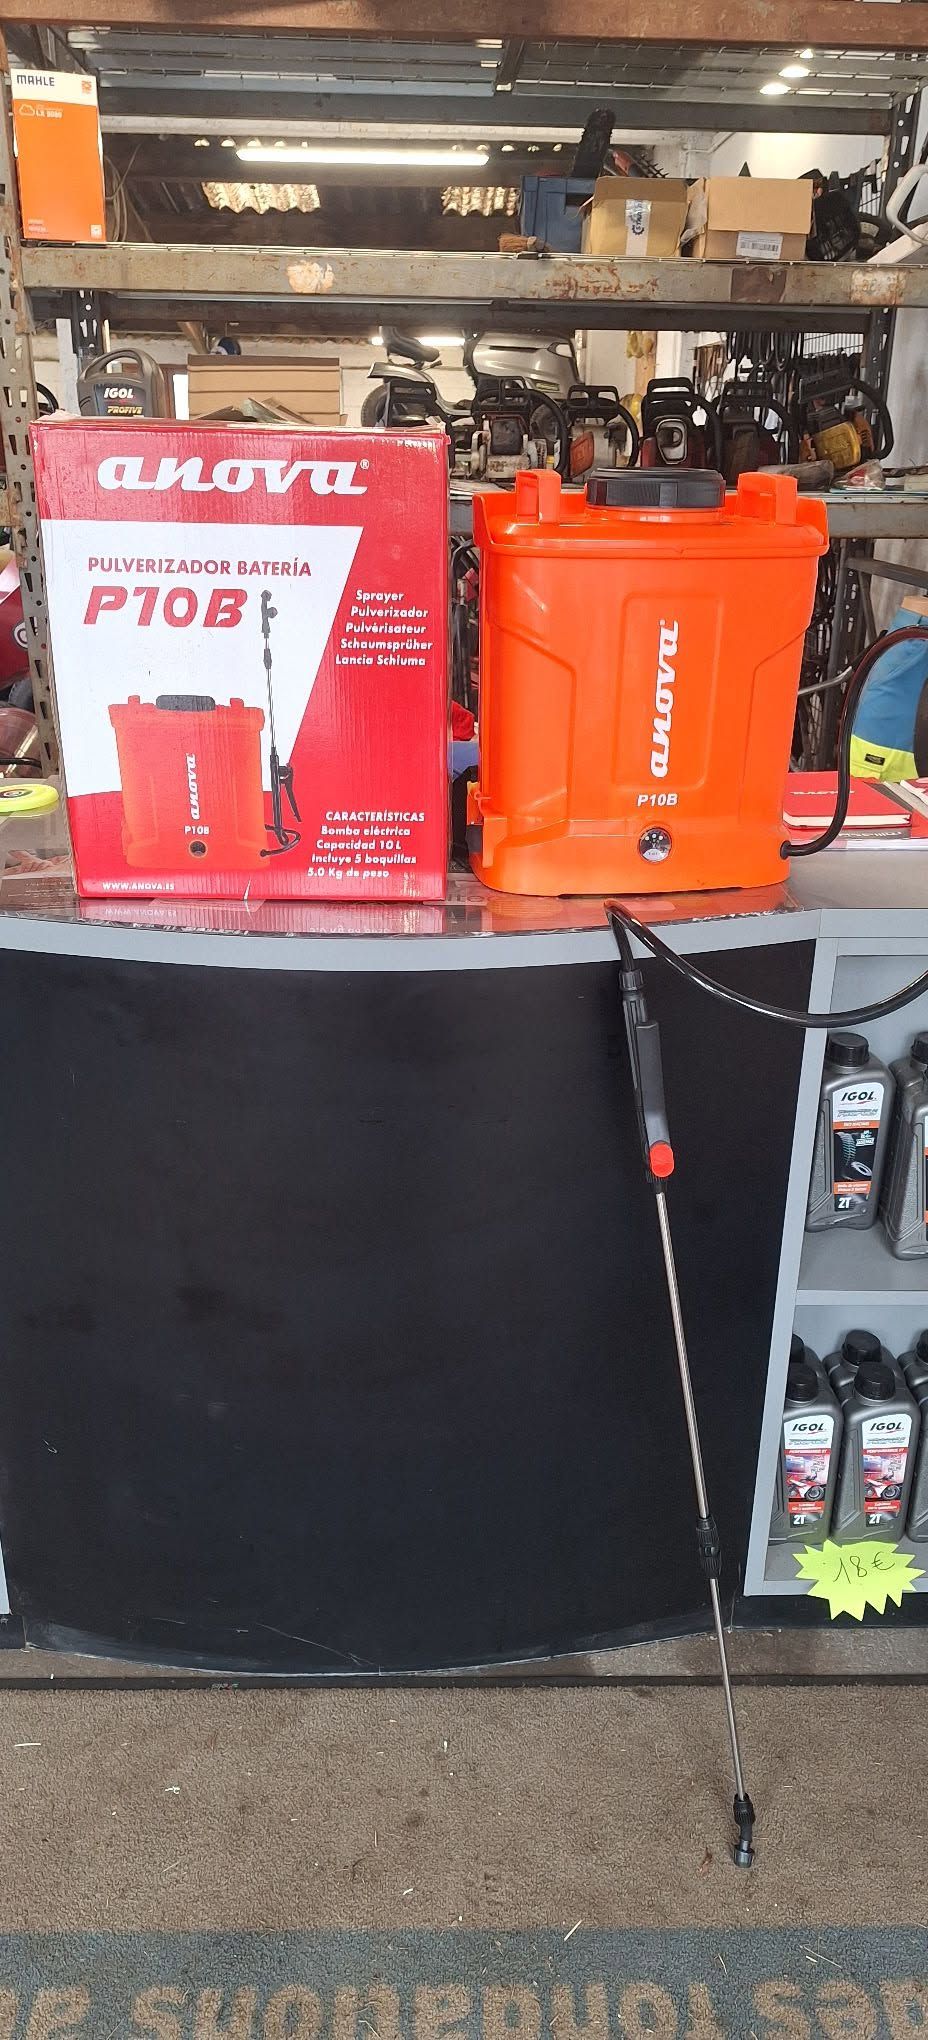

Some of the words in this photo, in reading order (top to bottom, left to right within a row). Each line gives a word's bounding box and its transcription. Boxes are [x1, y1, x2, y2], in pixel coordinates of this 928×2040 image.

[16, 74, 55, 87] MAHLE
[104, 387, 134, 399] IGOL
[88, 557, 231, 576] PULVERIZADOR
[237, 557, 312, 577] BATERÍA
[355, 589, 404, 604] Sprayer
[83, 585, 248, 628] P10B
[350, 605, 429, 618] Pulverizador
[345, 621, 427, 634] Pulvérisateur
[340, 637, 433, 653] Schaumsprüher
[335, 653, 374, 665] Lancia
[637, 793, 678, 807] P10B
[325, 809, 425, 822] CARACTERÍSTICAS
[184, 826, 210, 835] P10B
[321, 825, 360, 836] Bomba
[363, 825, 411, 836] eléctrica
[316, 839, 376, 851] Capacidad
[379, 840, 394, 850] 10
[395, 840, 402, 850] L
[311, 853, 351, 866] Incluye
[354, 853, 362, 864] 5
[364, 853, 417, 866] boquillas
[307, 867, 325, 877] 5.0
[328, 867, 343, 879] Kg
[346, 867, 360, 877] de
[362, 869, 390, 879] peso
[102, 882, 175, 891] WWW.ANOVA.ES
[841, 1091, 875, 1102] IGOL
[838, 1197, 852, 1209] 2T
[792, 1423, 824, 1431] IGOL
[870, 1422, 902, 1431] IGOL
[793, 1514, 807, 1525] 2T
[868, 1513, 882, 1524] 2T
[833, 1555, 868, 1584] 18
[871, 1551, 896, 1571] €
